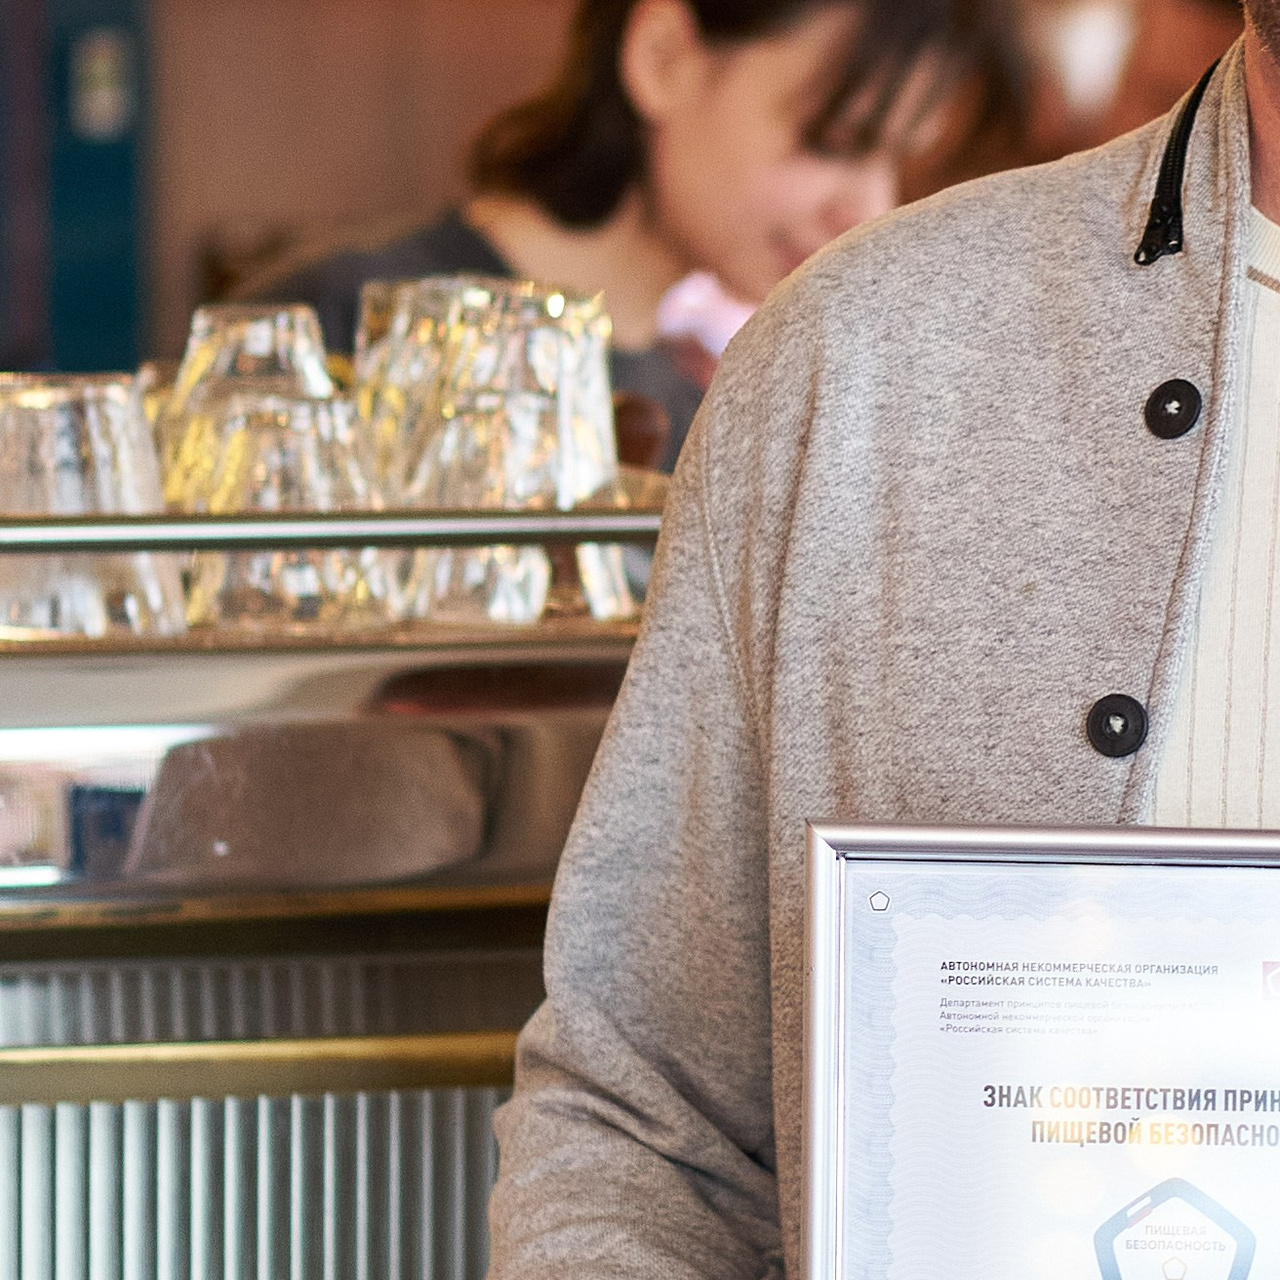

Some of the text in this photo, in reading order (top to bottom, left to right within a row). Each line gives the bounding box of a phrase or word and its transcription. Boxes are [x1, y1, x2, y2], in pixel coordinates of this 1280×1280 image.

[940, 961, 1218, 975] АВТОНОМНАЯ НЕКОММЕРЧЕСКАЯ ОРГАНИЗАЦИЯ
[939, 975, 1152, 988] «РОССИЙСКАЯ СИСТЕМА КАЧЕСТВА»
[938, 997, 1005, 1008] Департамент
[938, 1011, 1000, 1020] Автономной
[982, 1085, 1043, 1107] ЗНАК
[1049, 1087, 1217, 1111] СООТВЕТСТВИЯ
[1031, 1118, 1142, 1148] ПИЩЕВОЙ
[1144, 1224, 1207, 1237] ПИЩЕВАЯ
[1125, 1239, 1226, 1251] БЕЗОПАСНОСТЬ
